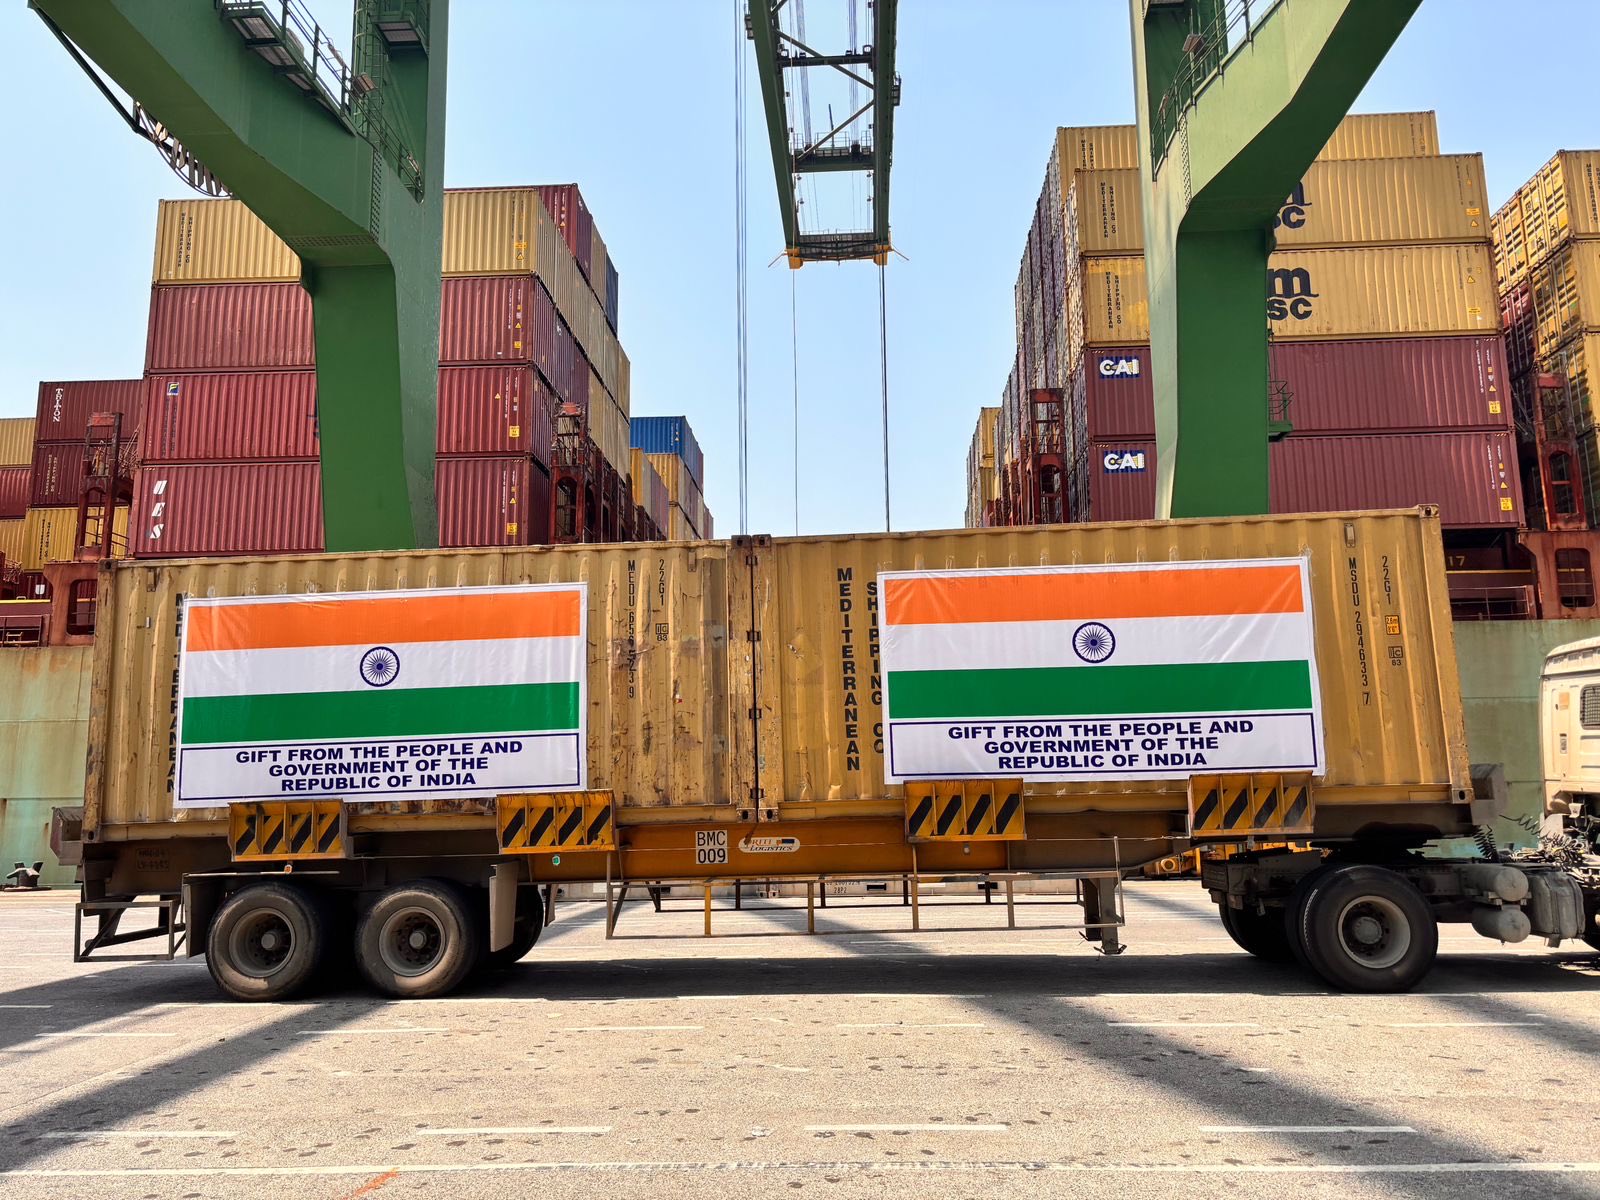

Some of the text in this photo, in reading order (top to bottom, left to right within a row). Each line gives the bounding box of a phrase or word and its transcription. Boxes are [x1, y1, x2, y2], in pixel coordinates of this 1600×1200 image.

[1101, 182, 1109, 238] MEDITERRANEAN
[1106, 271, 1114, 329] MEDITERRANEAN
[1116, 315, 1122, 325] CO
[1099, 358, 1140, 376] CAI
[53, 388, 64, 423] TRITON
[1103, 452, 1145, 470] CAI
[1382, 555, 1391, 605] 22G1
[1349, 557, 1360, 606] MSDU
[1355, 611, 1369, 687] 294633
[866, 581, 882, 706] SHIPPING
[837, 567, 860, 771] MEDITERRANEAN
[949, 721, 1253, 739] GIFT FROM THE PEOPLE AND
[236, 741, 523, 763] GIFT FROM THE PEOPLE AND
[985, 737, 1218, 753] GOVERNMENT OF THE
[269, 757, 488, 776] GOVERNMENT OF THE
[999, 753, 1207, 769] REPUBLIC OF INDIA
[281, 773, 476, 791] REPUBLIC OF INDIA
[697, 831, 725, 846] BMC
[698, 848, 726, 863] 009
